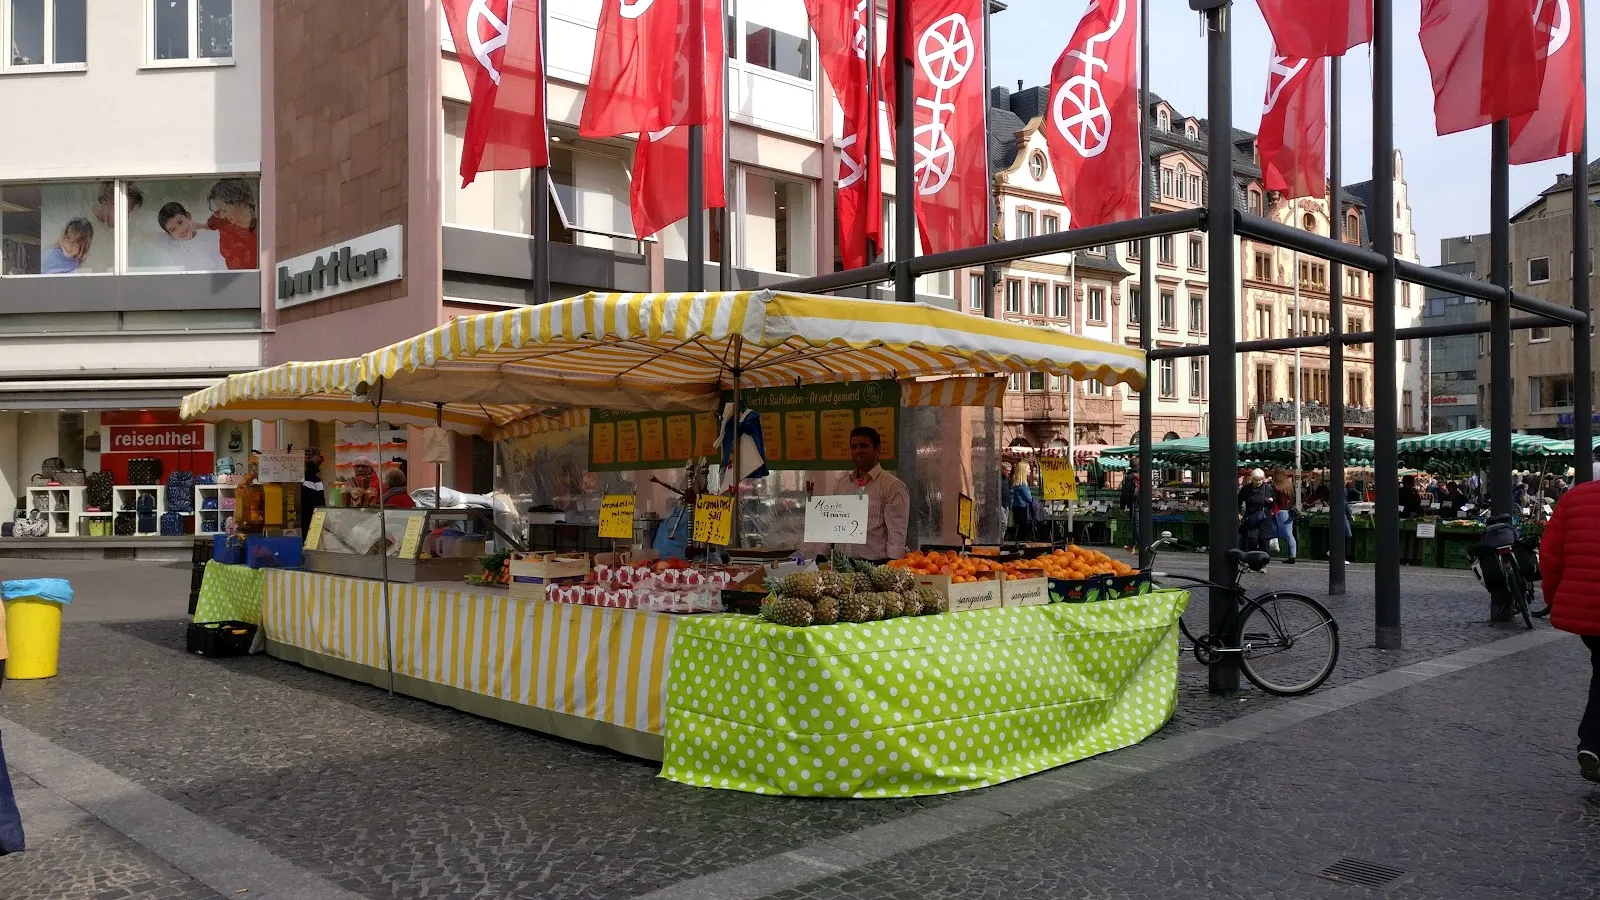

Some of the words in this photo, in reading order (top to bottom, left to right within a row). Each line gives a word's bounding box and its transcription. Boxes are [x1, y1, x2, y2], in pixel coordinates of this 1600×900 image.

[278, 246, 388, 299] buttler
[769, 393, 804, 405] Saftladen
[809, 391, 818, 404] fit
[819, 391, 833, 403] und
[833, 389, 860, 405] gesund
[115, 430, 196, 446] reisenthel
